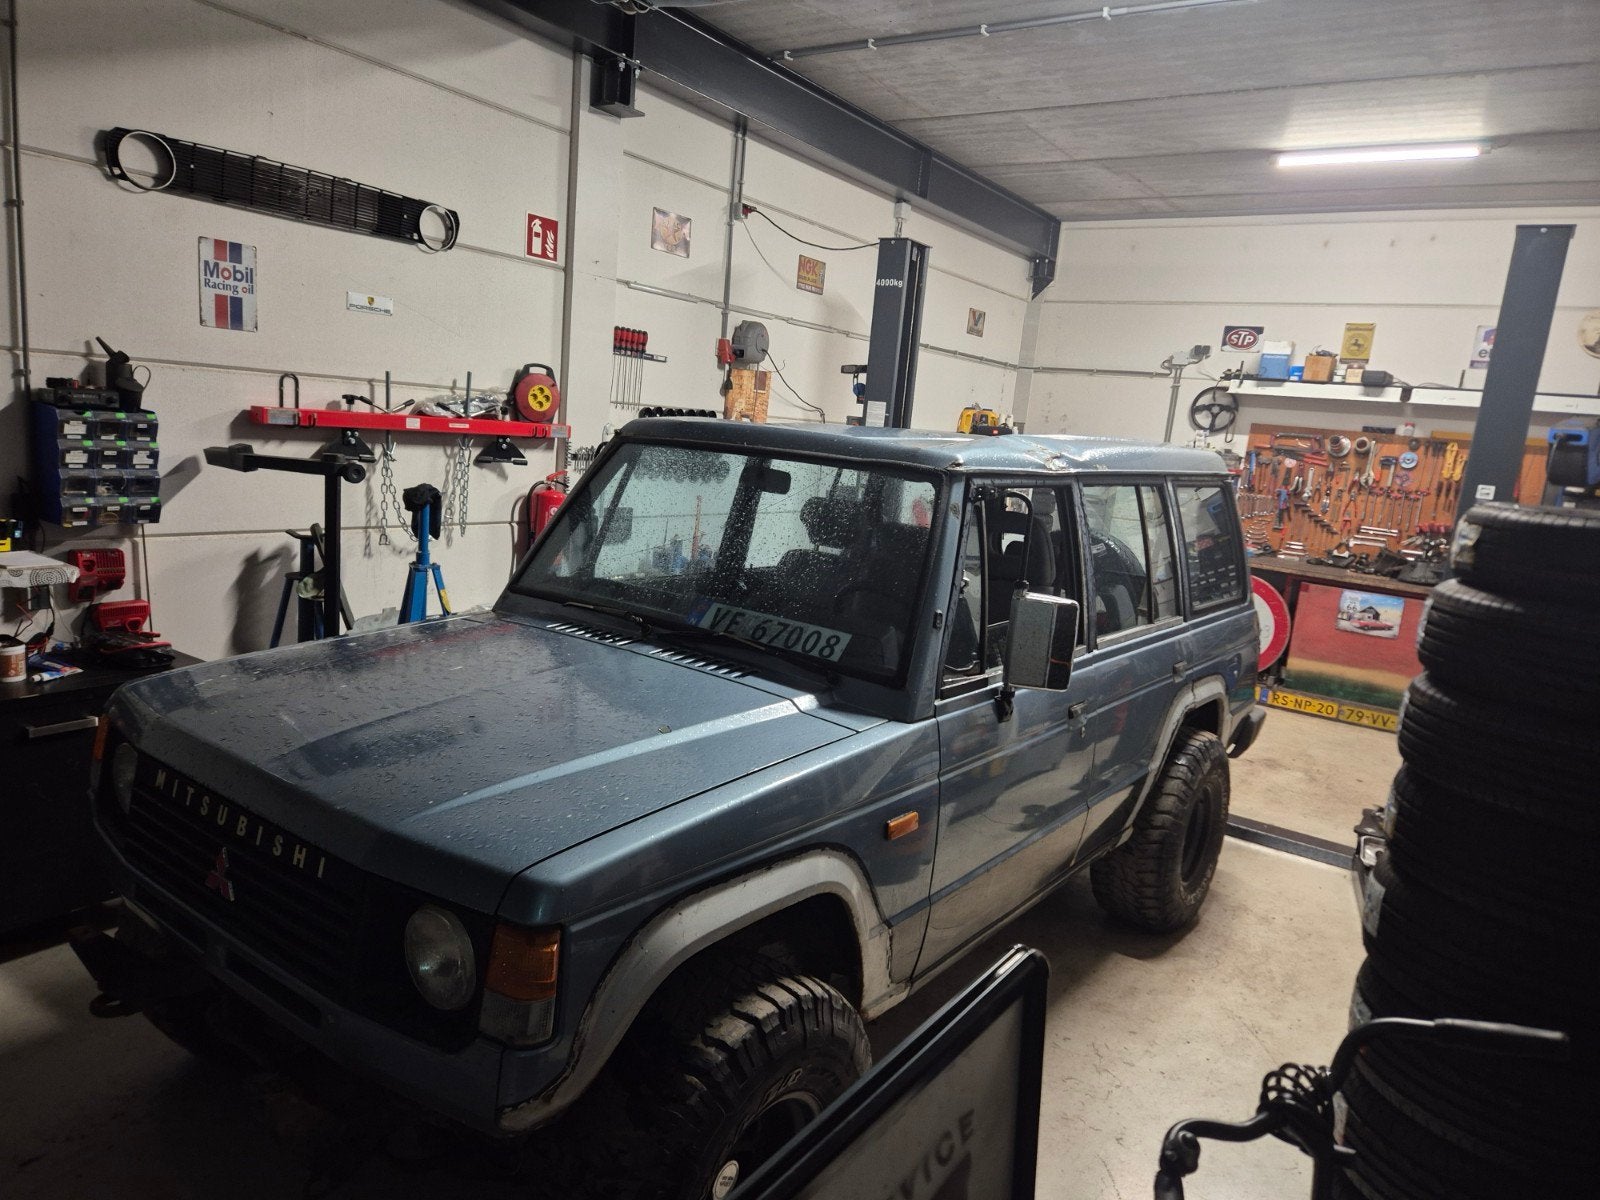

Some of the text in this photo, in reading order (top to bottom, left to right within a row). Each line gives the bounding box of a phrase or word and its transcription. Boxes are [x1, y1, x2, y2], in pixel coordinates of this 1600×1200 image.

[203, 260, 254, 285] Mobil
[876, 278, 903, 288] 4000kg
[204, 278, 254, 295] Racing oil
[1229, 331, 1255, 346] STP
[709, 607, 841, 659] VE 67008
[1271, 693, 1334, 715] RS-NP-20
[155, 769, 326, 879] MITSUBISHI
